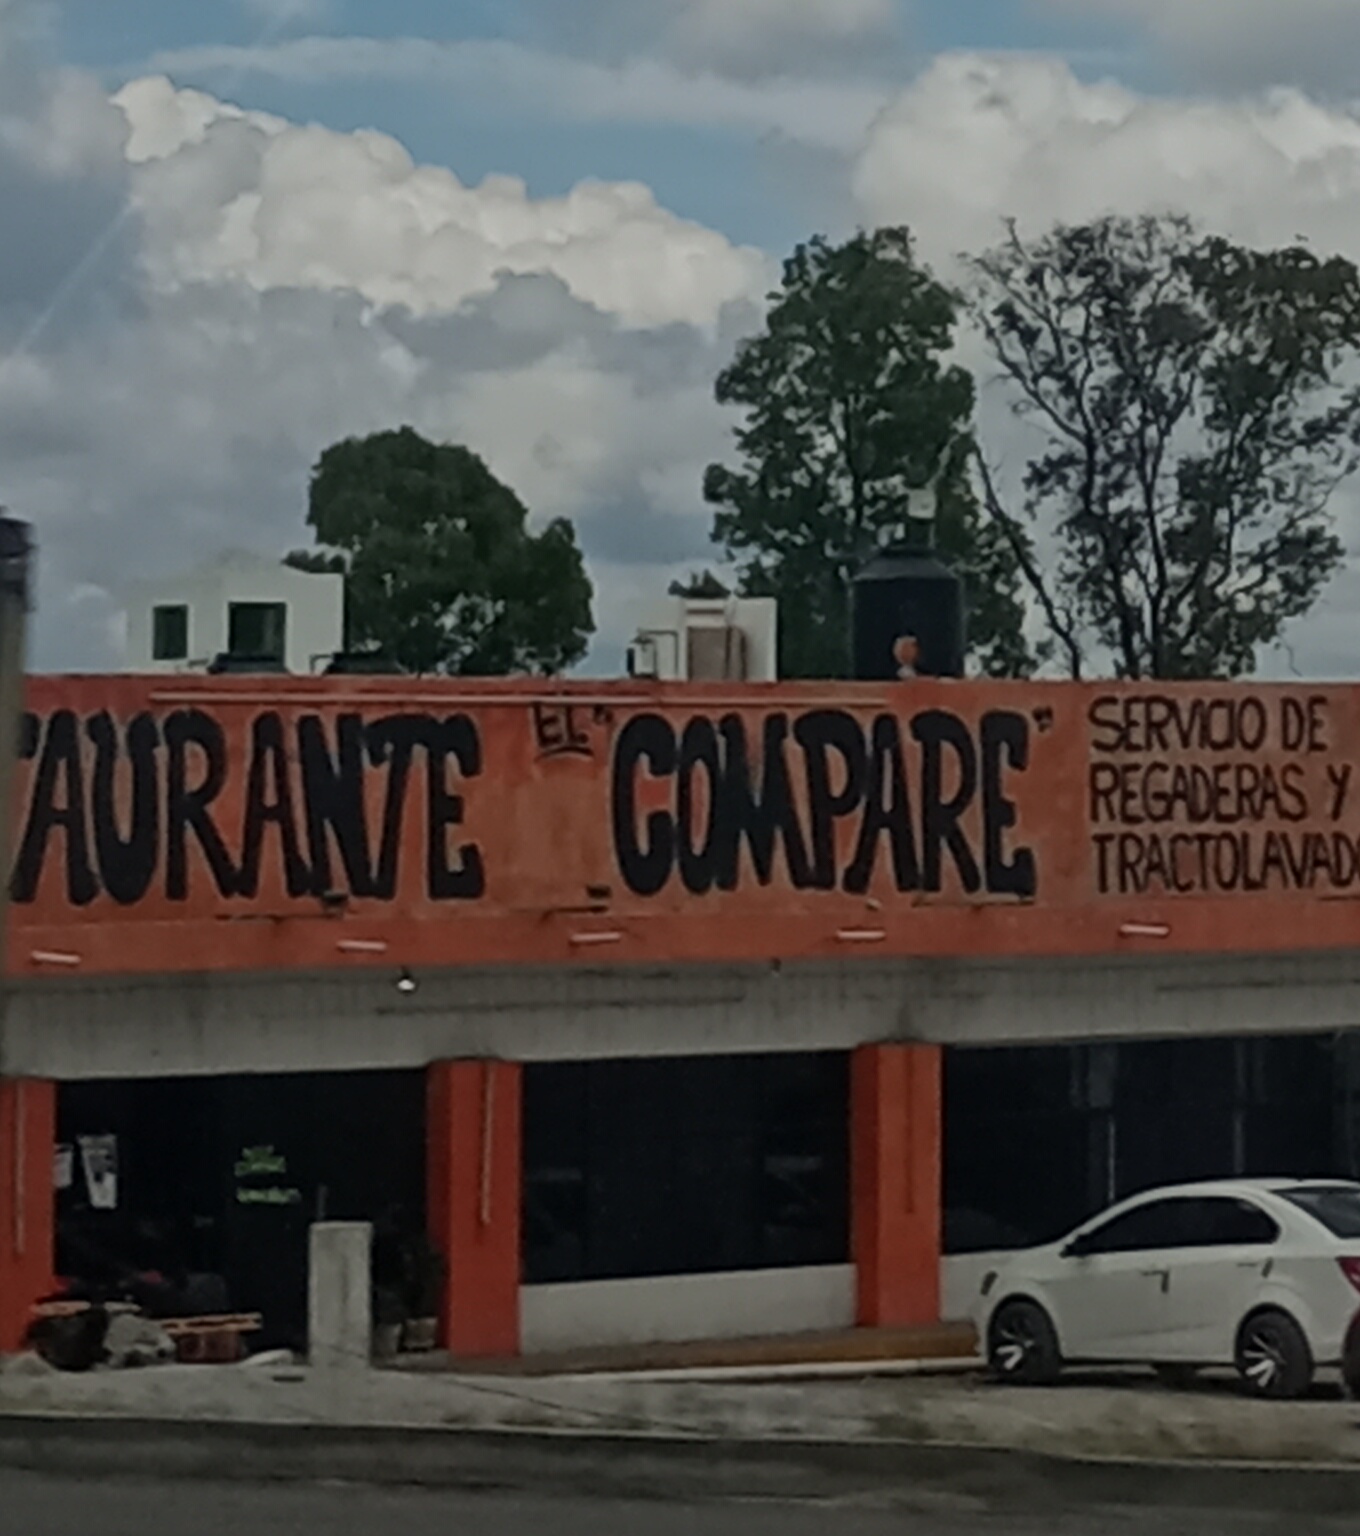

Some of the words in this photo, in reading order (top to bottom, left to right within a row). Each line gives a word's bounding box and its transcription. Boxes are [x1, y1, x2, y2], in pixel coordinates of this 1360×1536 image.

[1088, 696, 1267, 753] SERVICIO
[1281, 696, 1328, 756] DE
[1090, 762, 1308, 824] REGADERAS
[1325, 763, 1352, 822] Y
